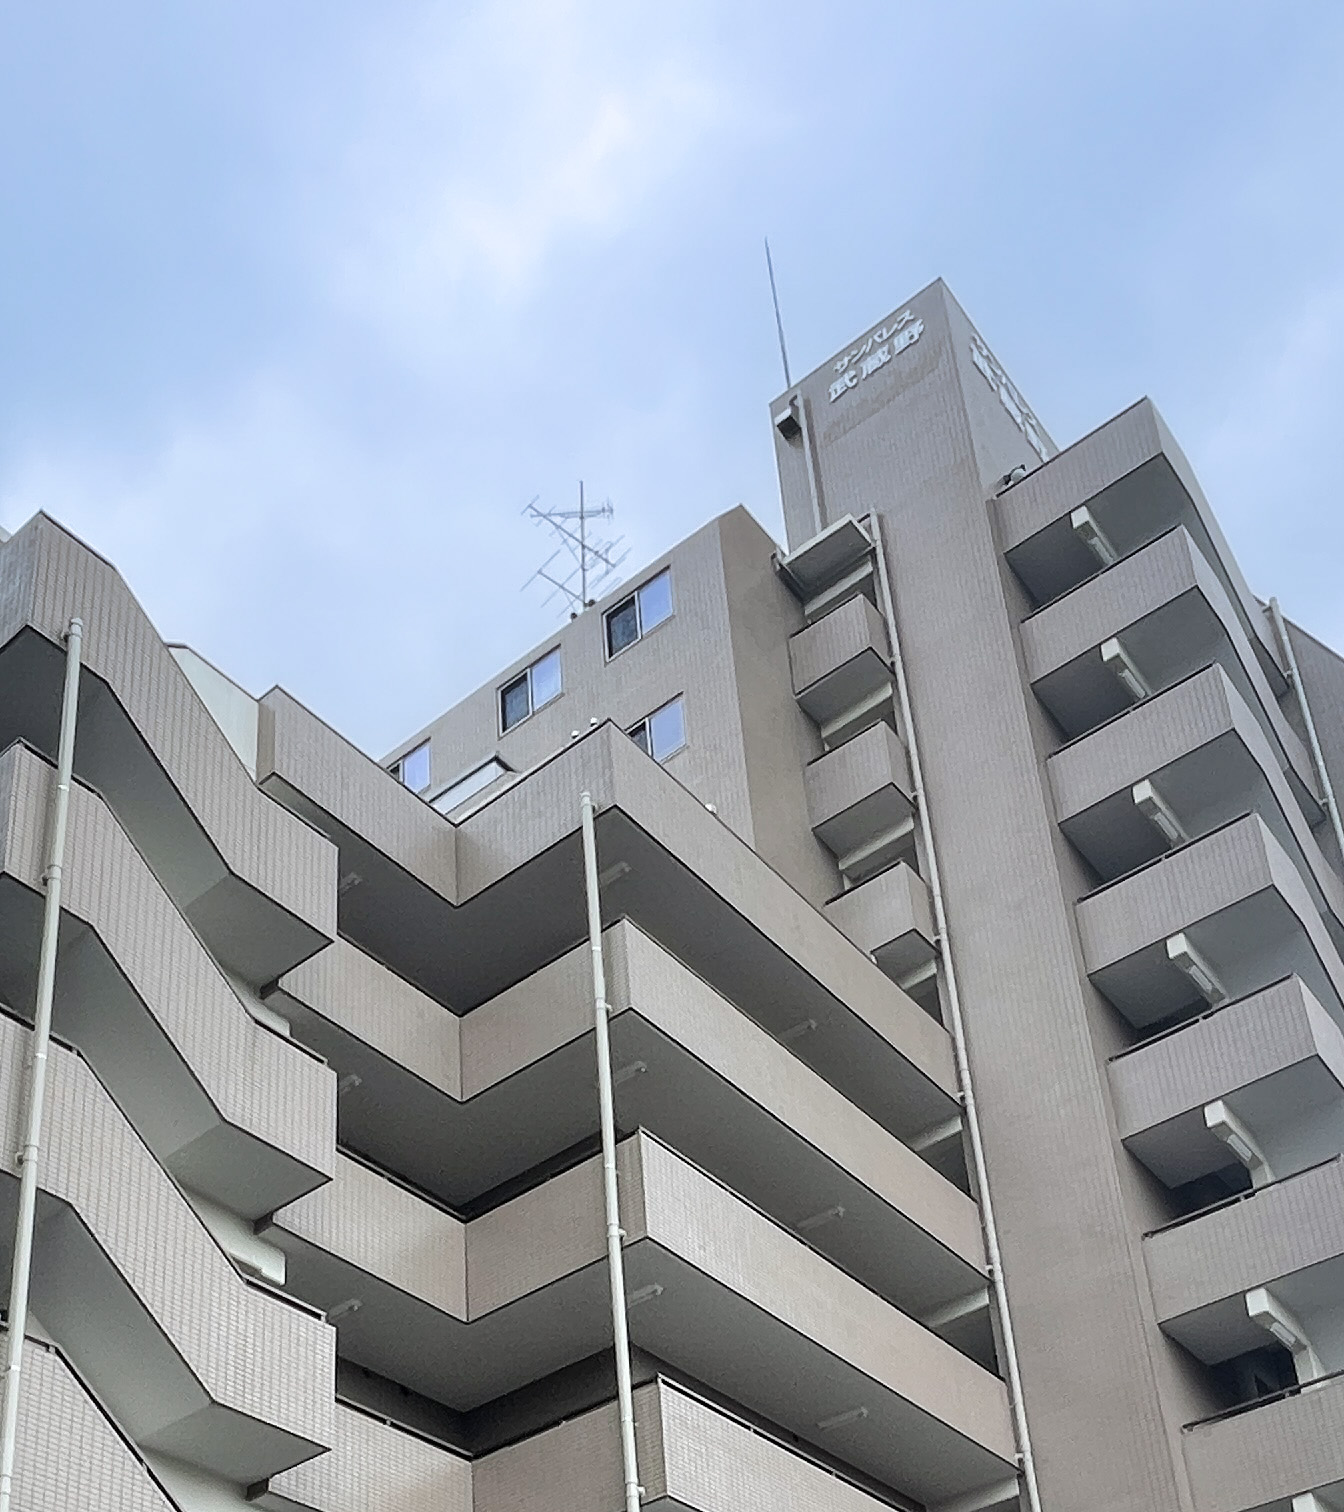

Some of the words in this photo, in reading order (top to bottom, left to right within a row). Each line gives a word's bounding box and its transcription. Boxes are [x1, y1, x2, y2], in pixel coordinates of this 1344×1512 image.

[828, 318, 925, 403] 武蔵野
[833, 309, 916, 374] サンパレス
